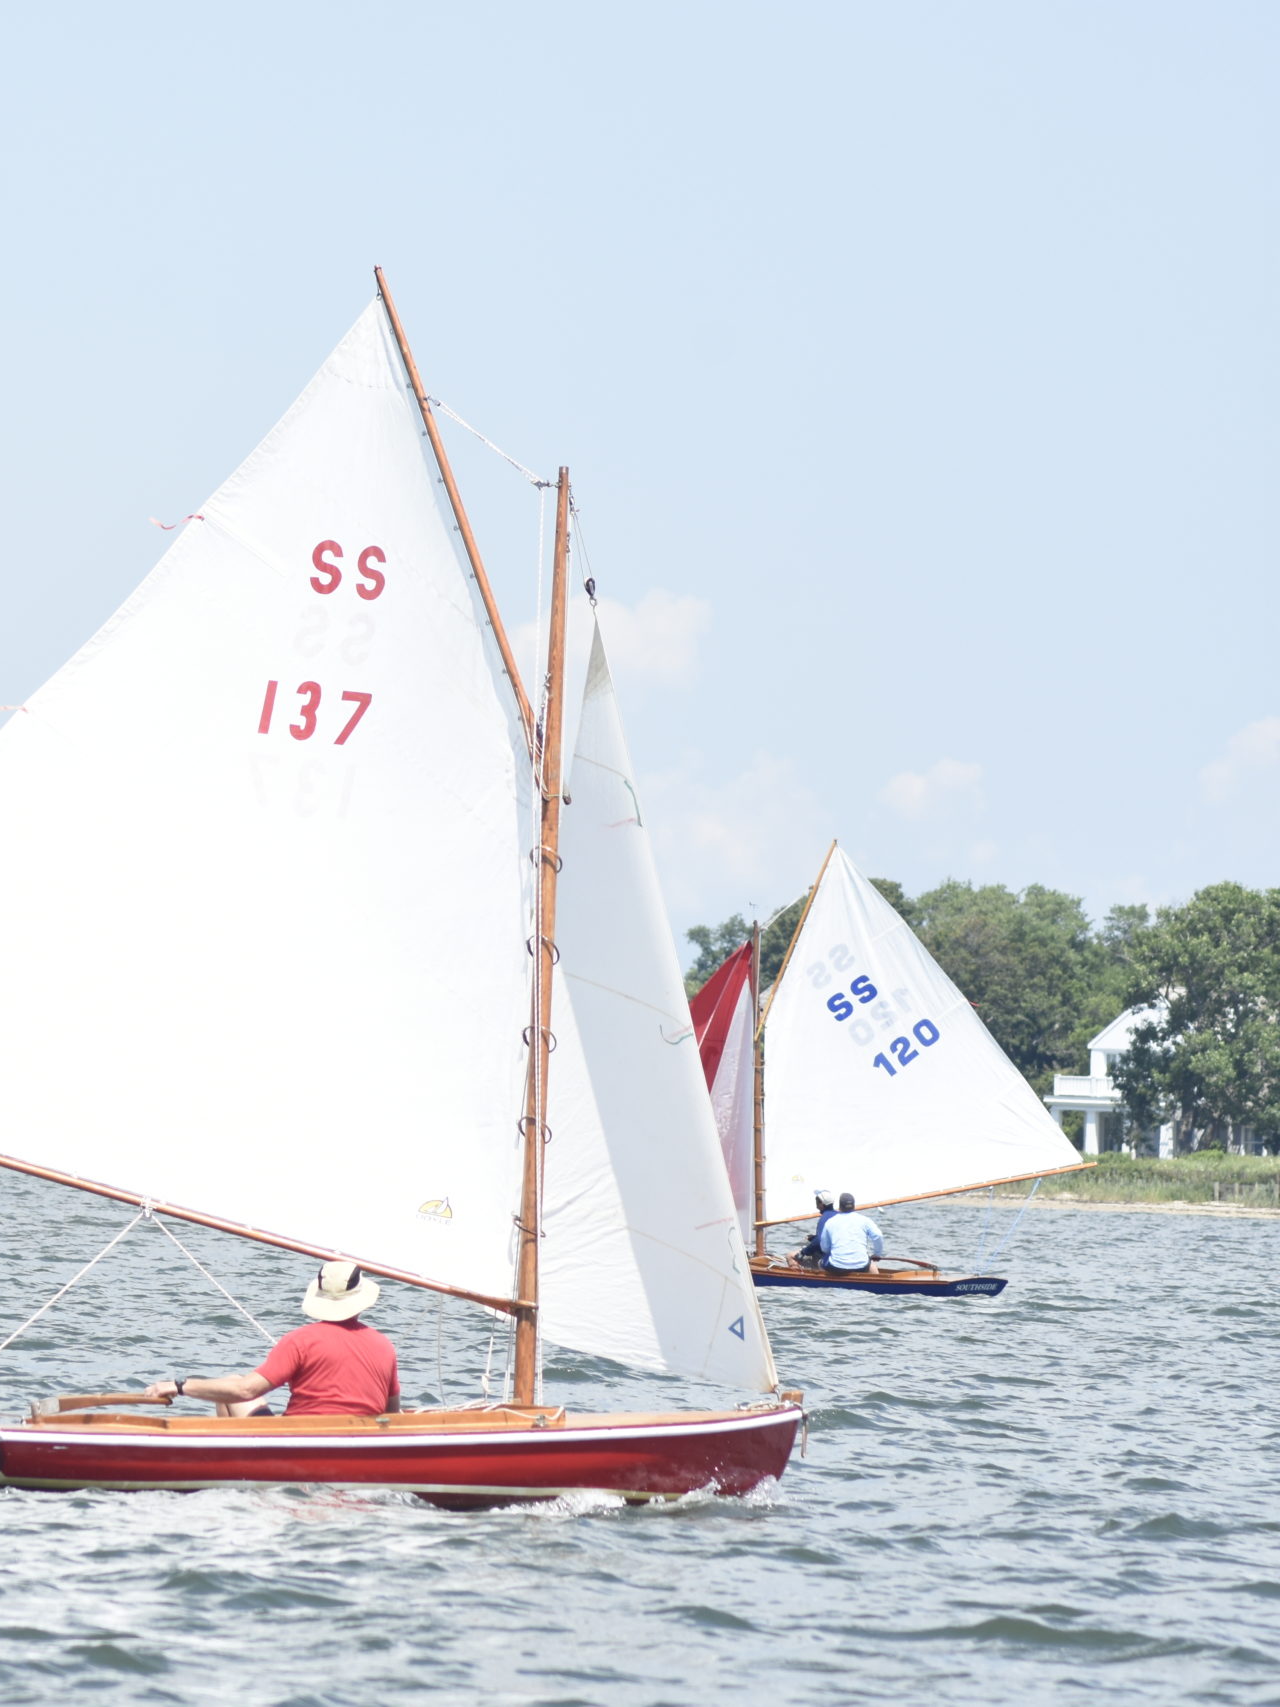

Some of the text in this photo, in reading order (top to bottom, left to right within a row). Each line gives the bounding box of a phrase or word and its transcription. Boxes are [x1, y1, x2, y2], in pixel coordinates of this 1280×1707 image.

[310, 540, 387, 601] SS
[258, 679, 373, 746] 137
[826, 974, 878, 1022] SS
[872, 1018, 940, 1077] 120
[955, 1283, 998, 1291] SOUTHSIDE
